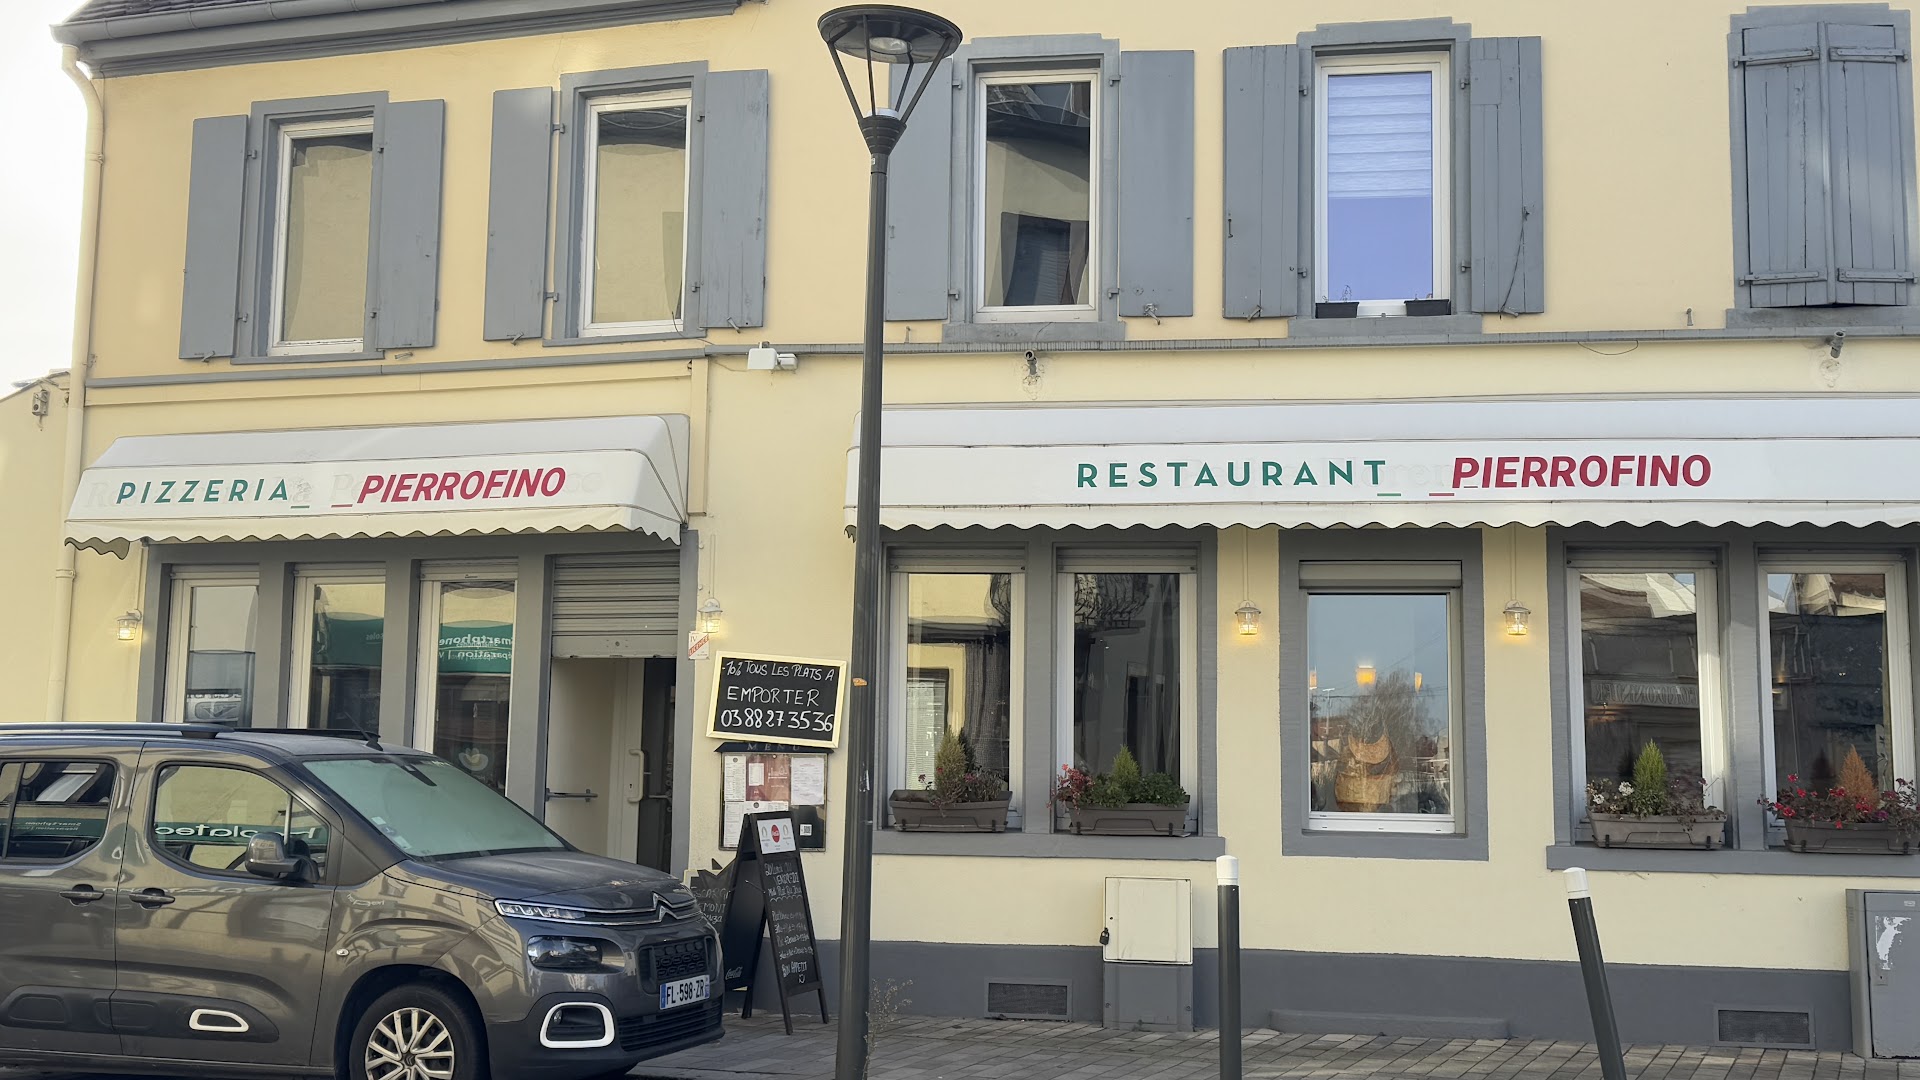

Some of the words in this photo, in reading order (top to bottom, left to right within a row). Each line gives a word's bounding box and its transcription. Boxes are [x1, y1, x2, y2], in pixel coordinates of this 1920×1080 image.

[1077, 460, 1386, 488] RESTAURANT
[1452, 455, 1711, 488] PIERROFINO
[116, 478, 288, 504] PIZZERIA
[356, 467, 566, 504] PIERROFINO
[744, 660, 768, 676] TOUS
[771, 662, 790, 677] LES
[791, 663, 822, 681] PLATS
[824, 668, 835, 681] A
[726, 685, 820, 707] EMPORTER
